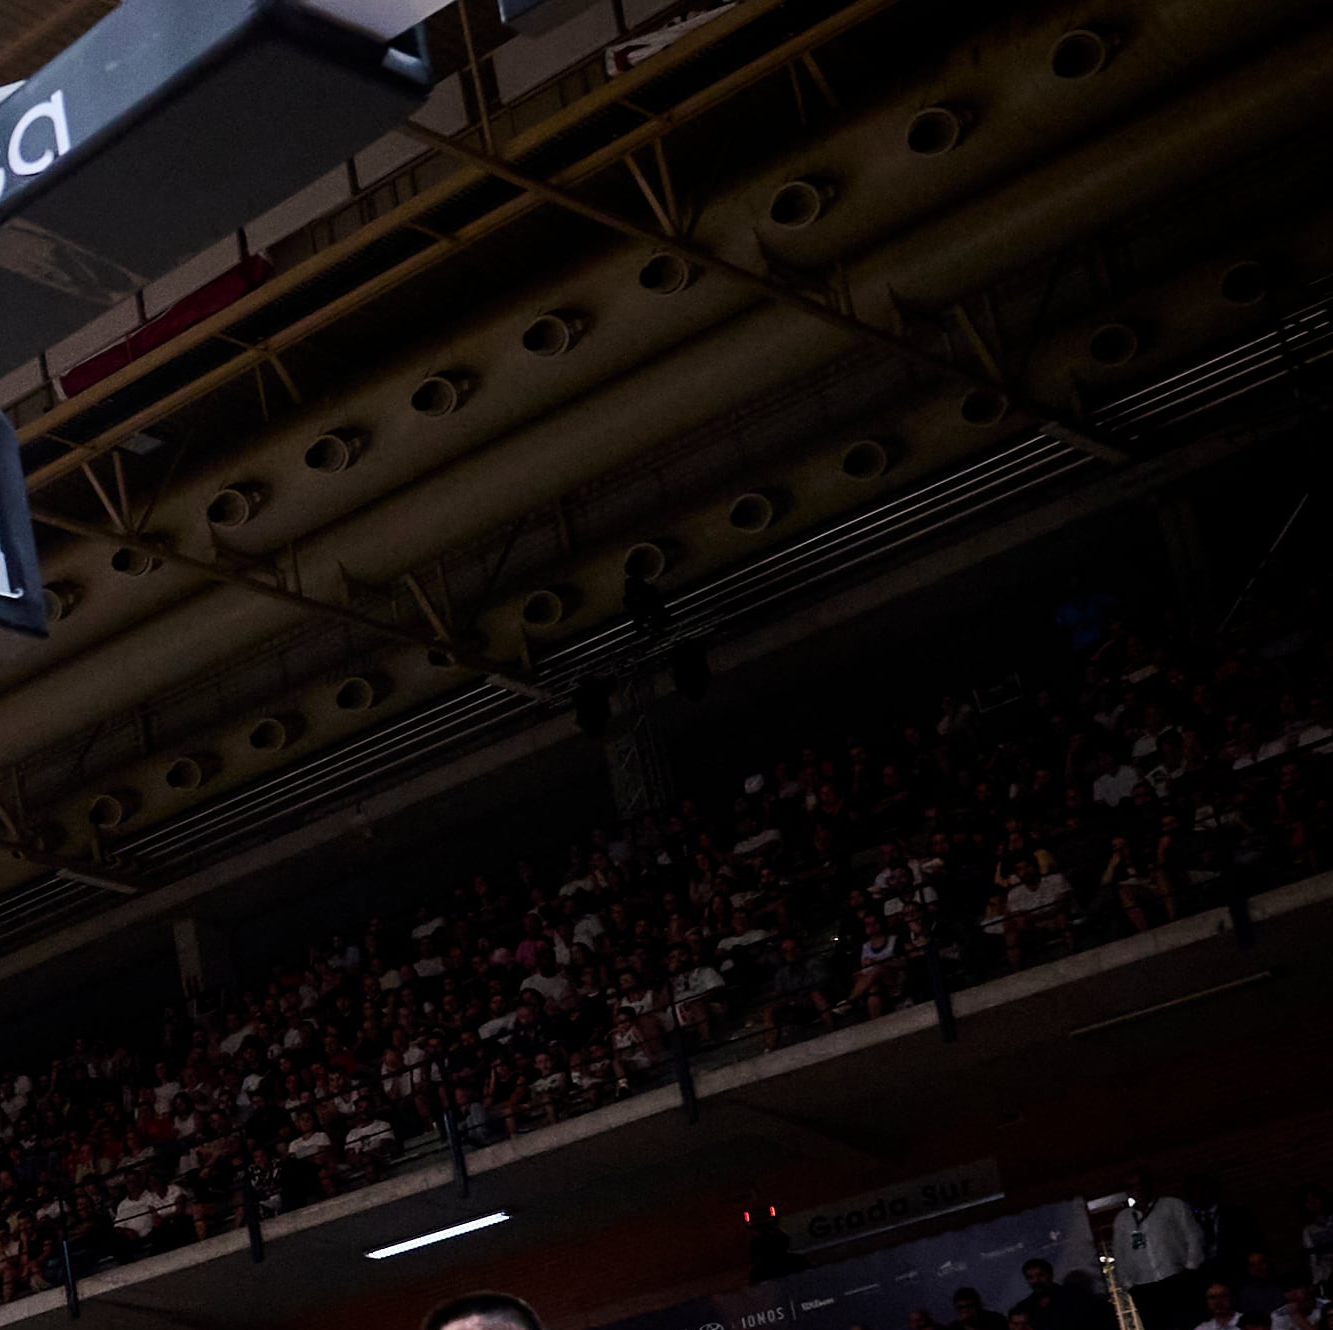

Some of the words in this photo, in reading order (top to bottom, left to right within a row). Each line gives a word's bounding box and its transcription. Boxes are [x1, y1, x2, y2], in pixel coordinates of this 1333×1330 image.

[809, 1196, 909, 1239] Grada
[921, 1179, 970, 1207] Sur
[741, 1306, 785, 1329] IONOS
